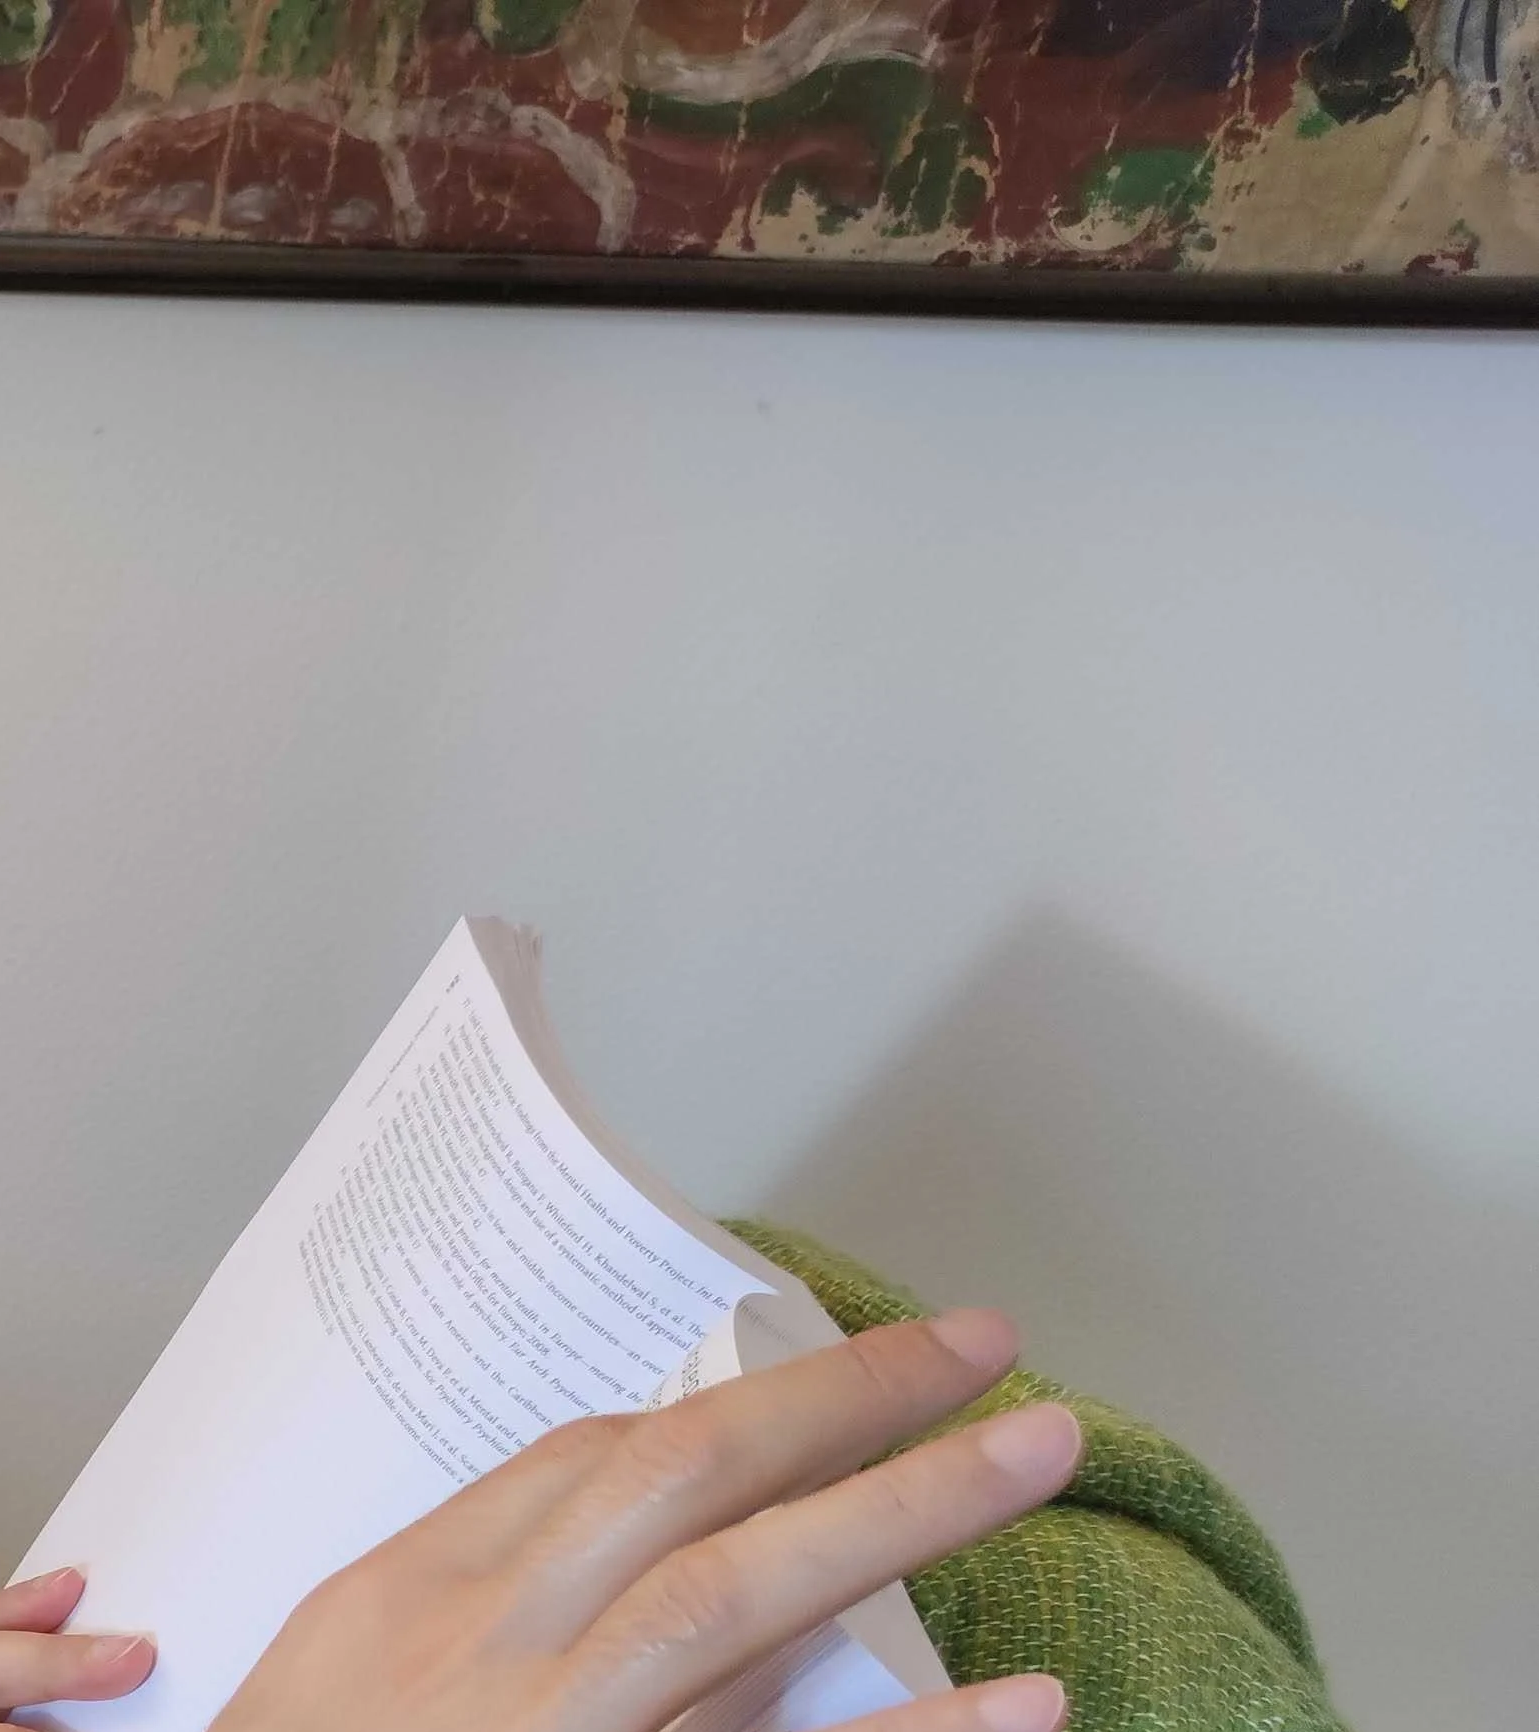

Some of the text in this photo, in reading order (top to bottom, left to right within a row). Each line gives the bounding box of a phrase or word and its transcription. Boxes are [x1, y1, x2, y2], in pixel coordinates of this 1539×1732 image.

[556, 1162, 585, 1192] Mental
[580, 1189, 607, 1218] Health
[606, 1217, 627, 1234] and
[623, 1230, 660, 1263] Poverty
[594, 1253, 651, 1300] Khandelwal
[659, 1307, 672, 1317] et
[671, 1315, 686, 1326] al.
[599, 1283, 639, 1314] method
[513, 1297, 539, 1324] health
[538, 1323, 550, 1334] in
[444, 1319, 473, 1353] America
[473, 1354, 492, 1371] and
[490, 1371, 505, 1386] the
[526, 1360, 549, 1379] Arch
[467, 1394, 500, 1424] Mental
[495, 1424, 517, 1439] and
[514, 1438, 528, 1451] ne
[460, 1454, 480, 1476] Scarc
